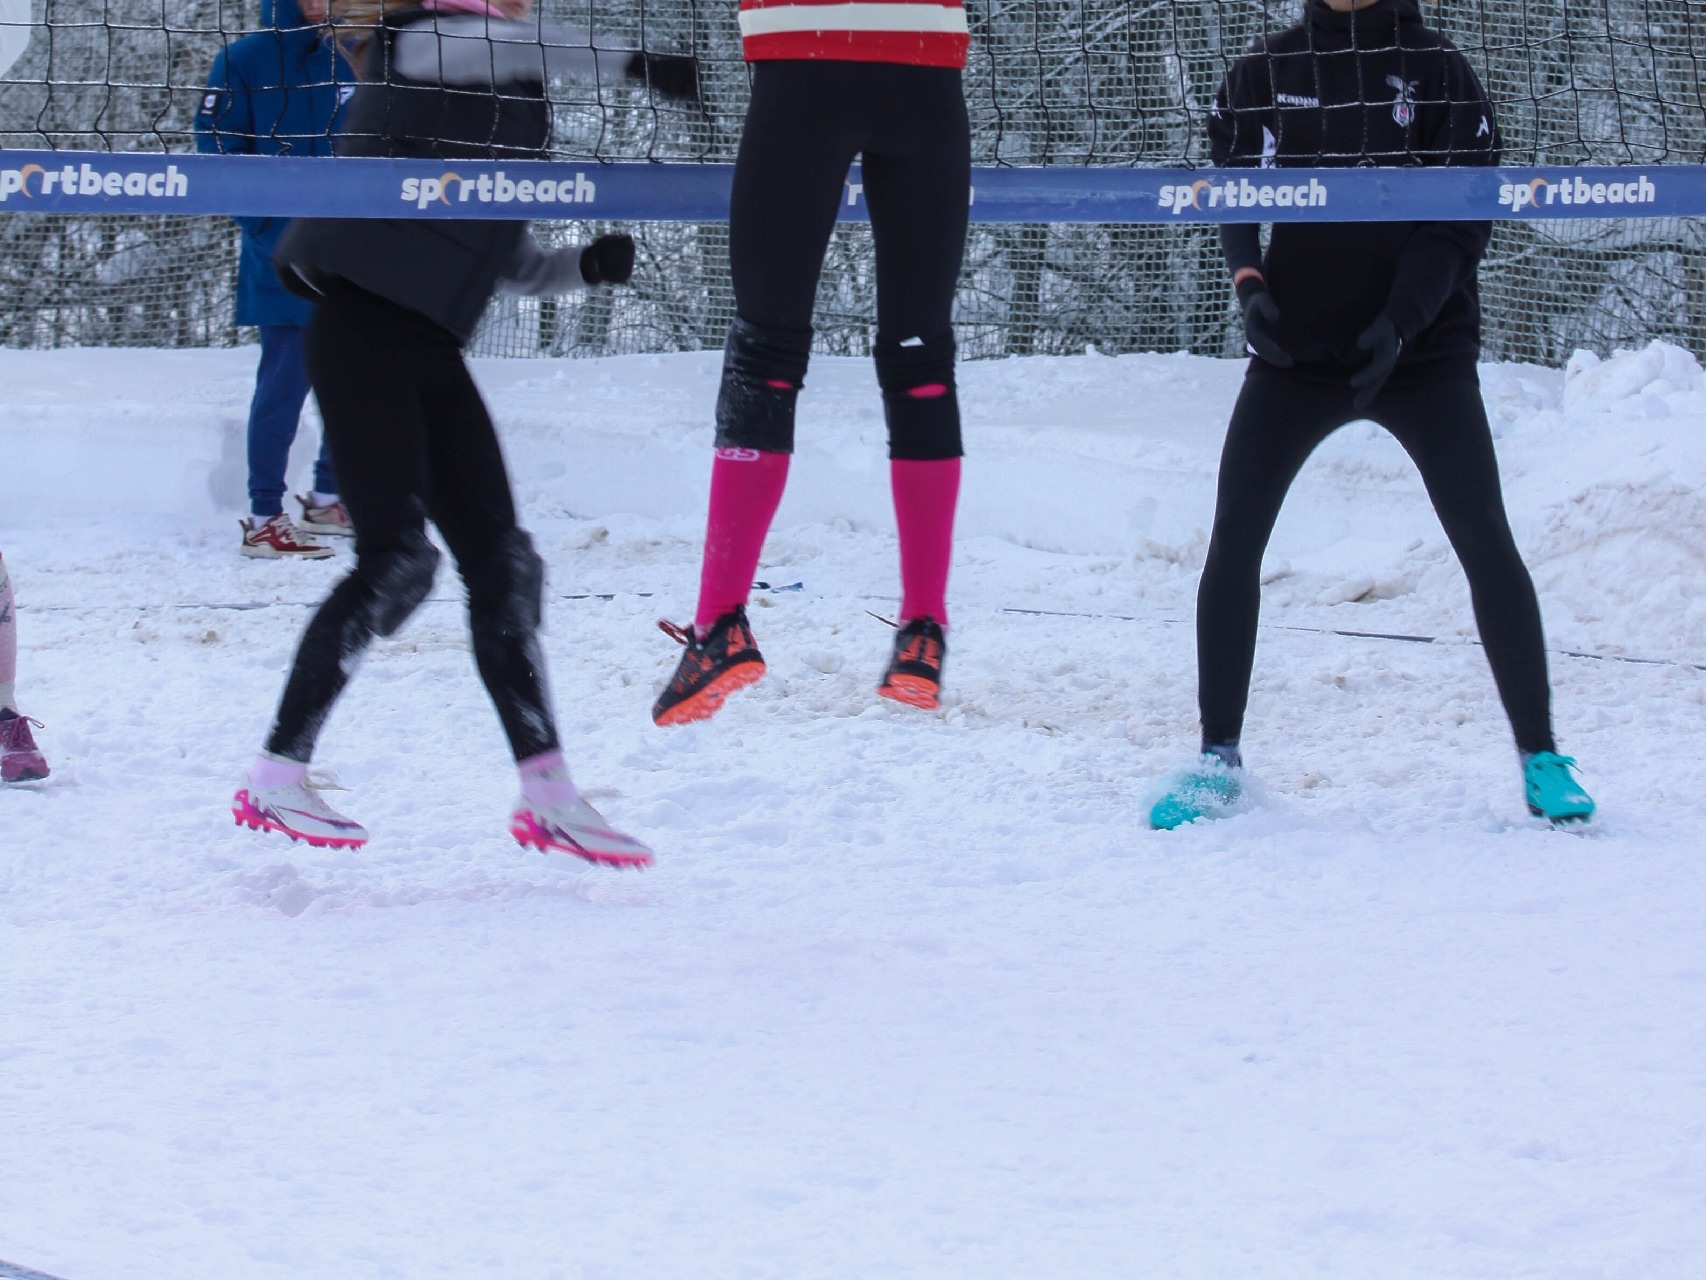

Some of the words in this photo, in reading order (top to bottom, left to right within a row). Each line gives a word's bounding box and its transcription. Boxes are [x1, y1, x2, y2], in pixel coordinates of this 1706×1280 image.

[0, 163, 188, 202] portbeach
[401, 171, 596, 209] sportbeach
[1158, 178, 1328, 214] sportbeach
[1498, 175, 1656, 211] sportbeach
